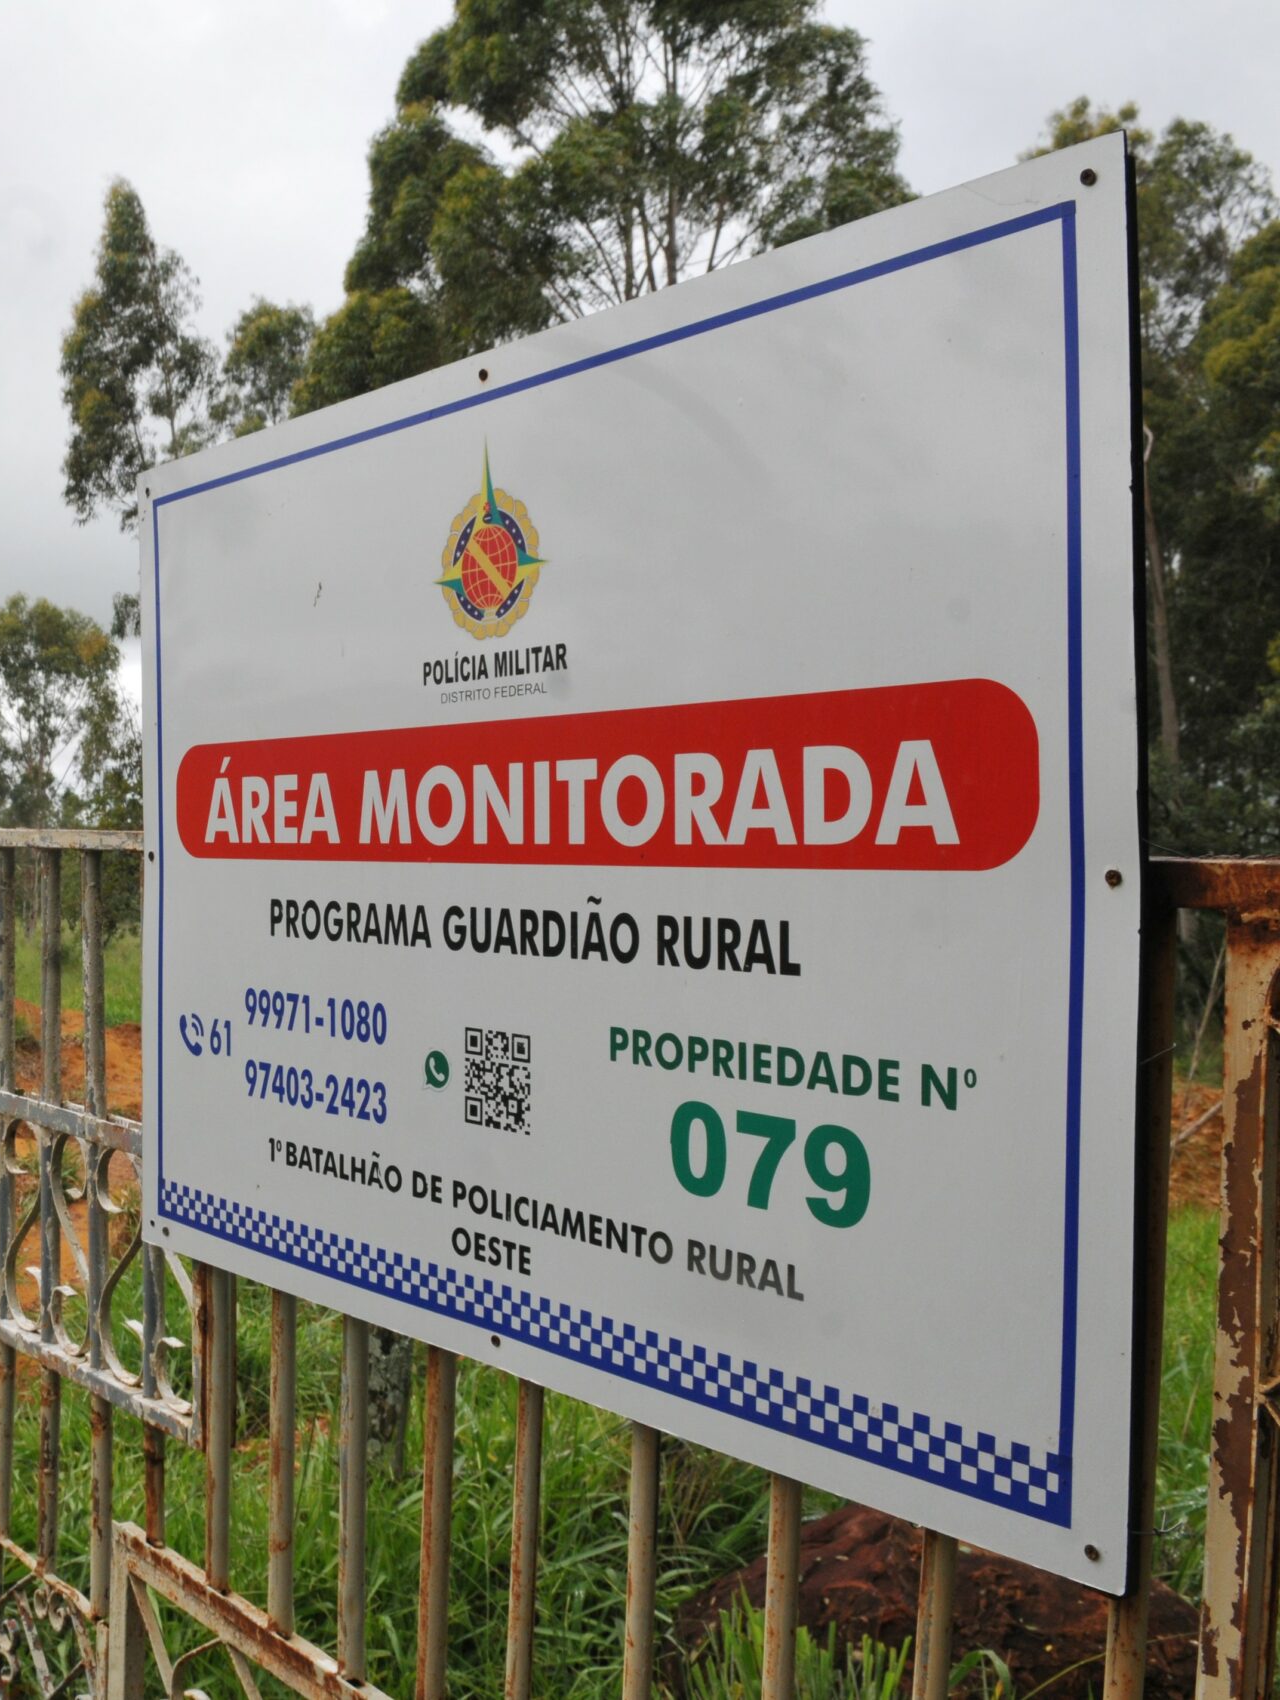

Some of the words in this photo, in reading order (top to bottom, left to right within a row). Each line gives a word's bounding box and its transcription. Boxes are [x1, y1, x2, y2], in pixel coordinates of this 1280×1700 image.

[423, 651, 489, 686] POLÍCIA
[494, 643, 568, 678] MILITAR
[440, 687, 491, 704] DISTRITO
[494, 681, 548, 699] FEDERAL
[205, 757, 340, 844] ÁREA
[358, 740, 960, 847] MONITORADA
[270, 898, 432, 948] PROGRAMA
[443, 896, 640, 964] GUARDIÃO
[657, 915, 802, 977] RURAL
[210, 1019, 232, 1057] 61
[245, 988, 388, 1045] 99971-1080
[245, 1059, 388, 1125] 97403-2423
[610, 1027, 900, 1103] PROPRIEDADE
[670, 1101, 872, 1229] 079
[286, 1141, 403, 1194] BATALHÃO
[412, 1170, 443, 1205] DE
[452, 1180, 674, 1266] POLICIAMENTO
[687, 1239, 805, 1302] RURAL
[451, 1226, 532, 1276] OESTE
